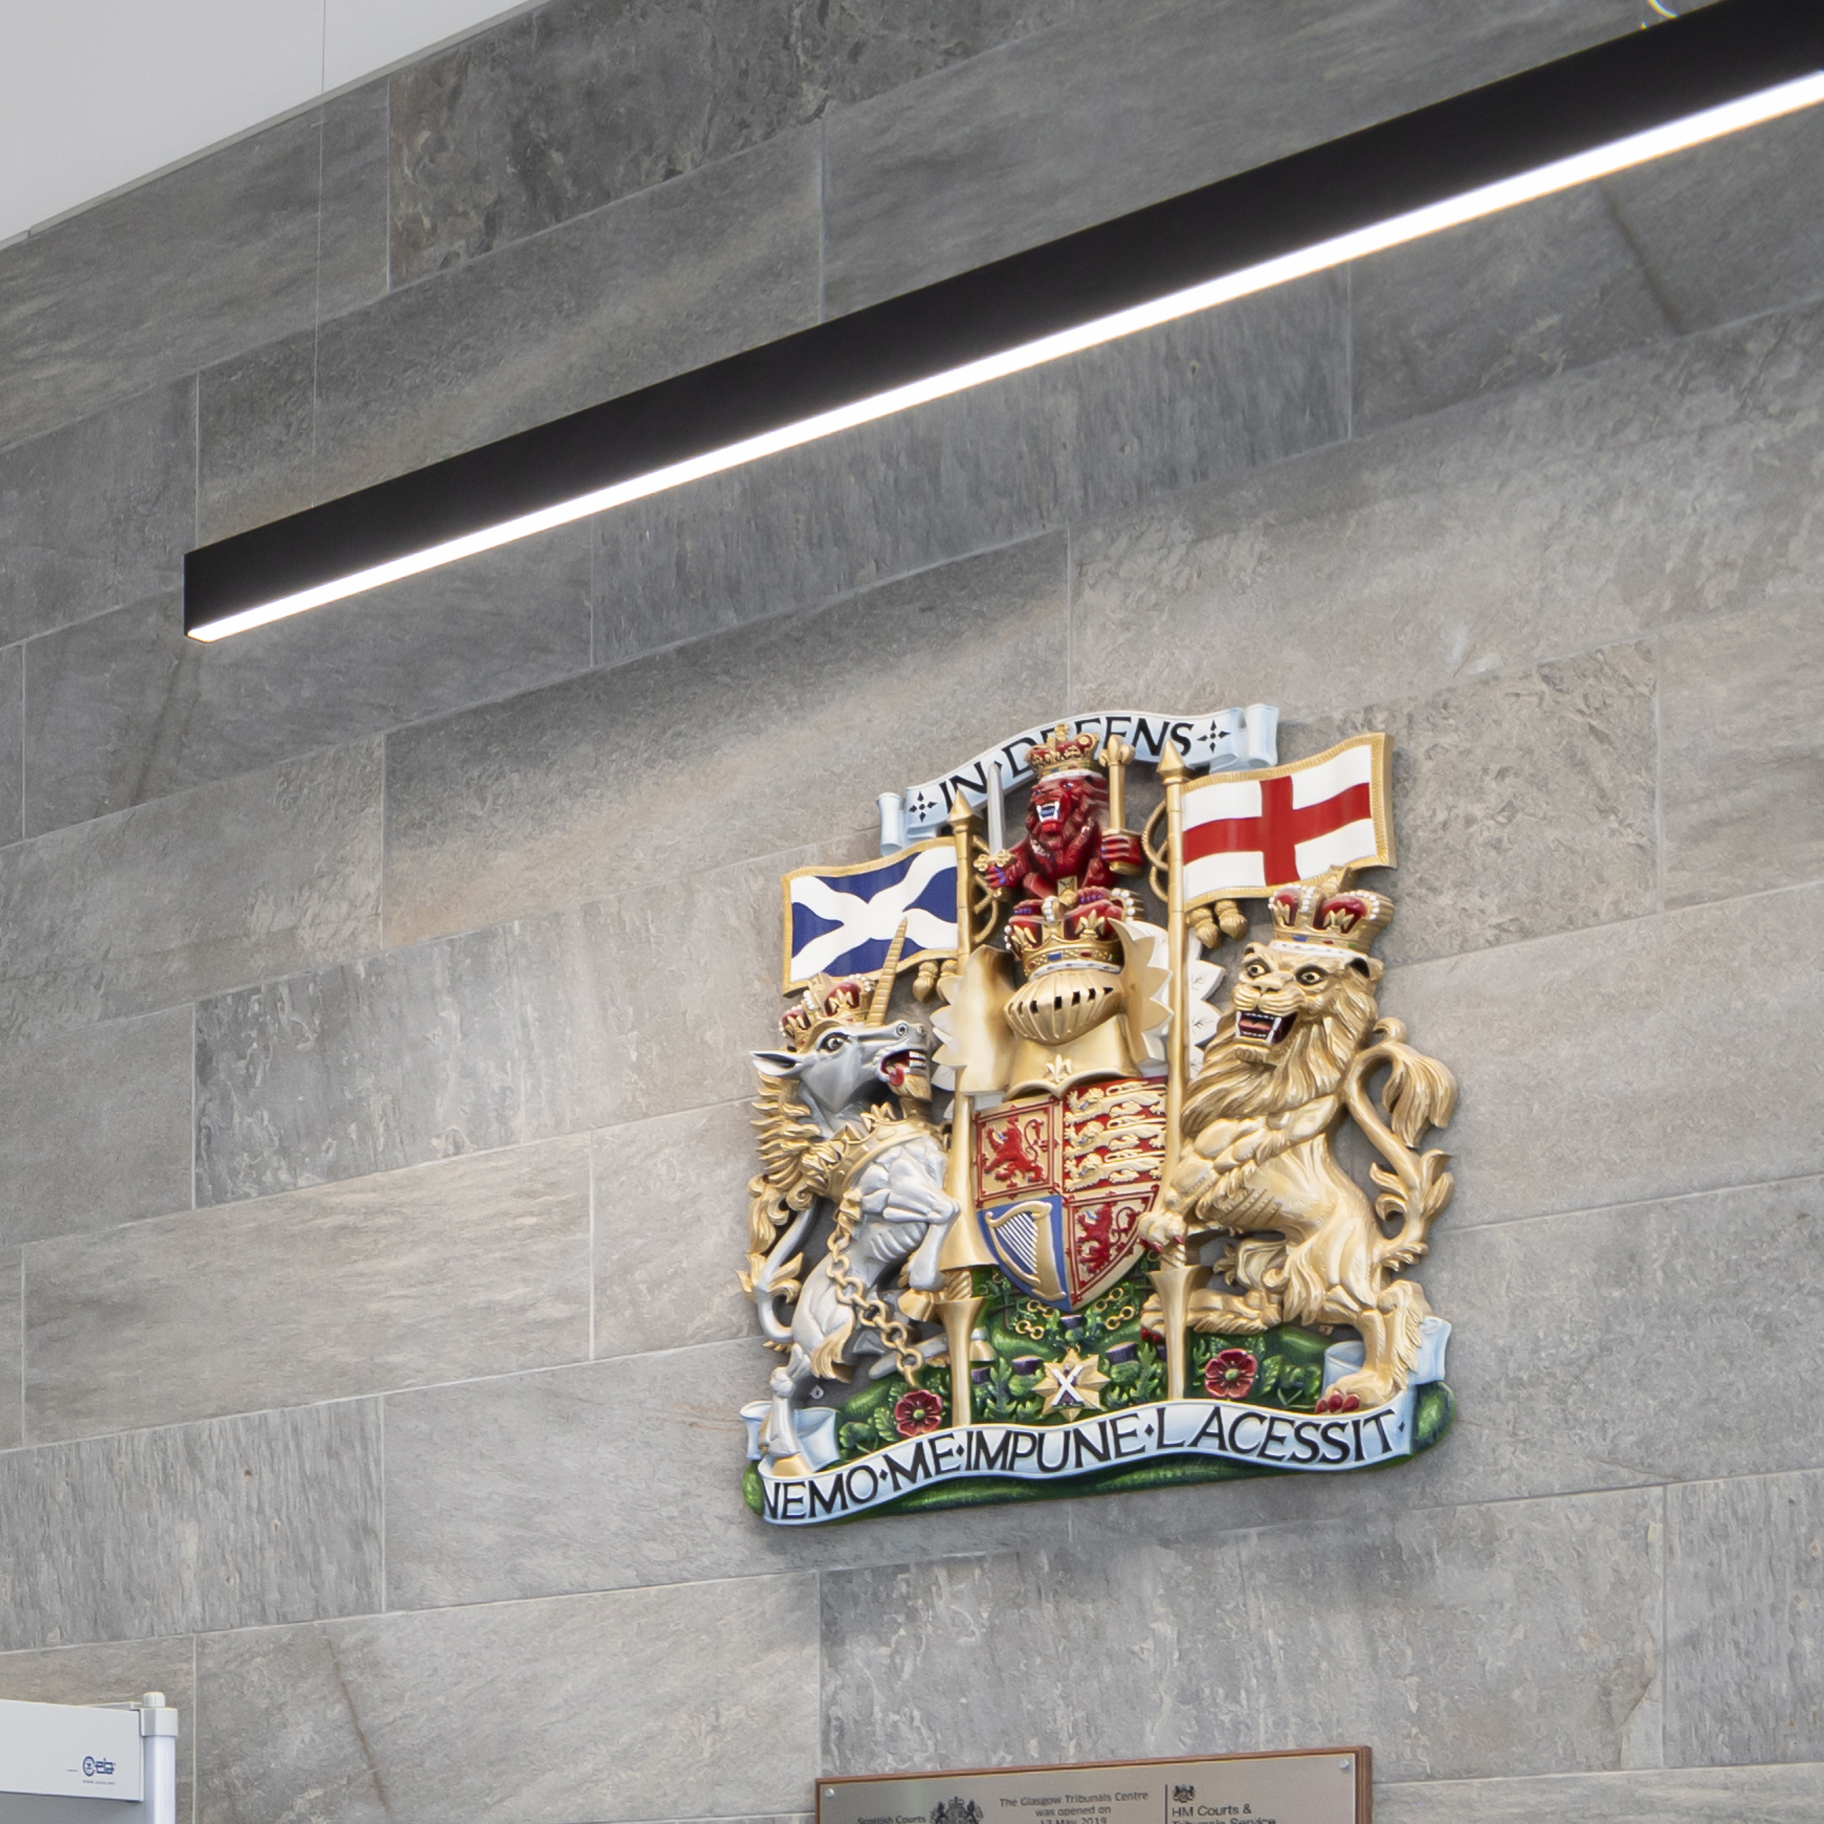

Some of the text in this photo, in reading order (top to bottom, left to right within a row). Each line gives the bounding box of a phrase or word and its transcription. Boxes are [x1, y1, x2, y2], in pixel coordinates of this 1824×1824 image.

[1001, 716, 1194, 778] DENS
[763, 1464, 879, 1520] NEMO
[883, 1433, 960, 1491] ME
[965, 1412, 1146, 1472] IMPUNE
[999, 1791, 1149, 1807] The Glasgow Tribunals Centre
[1035, 1806, 1111, 1817] was opened on
[1172, 1803, 1252, 1817] HM Courts &
[895, 1815, 926, 1824] Courts
